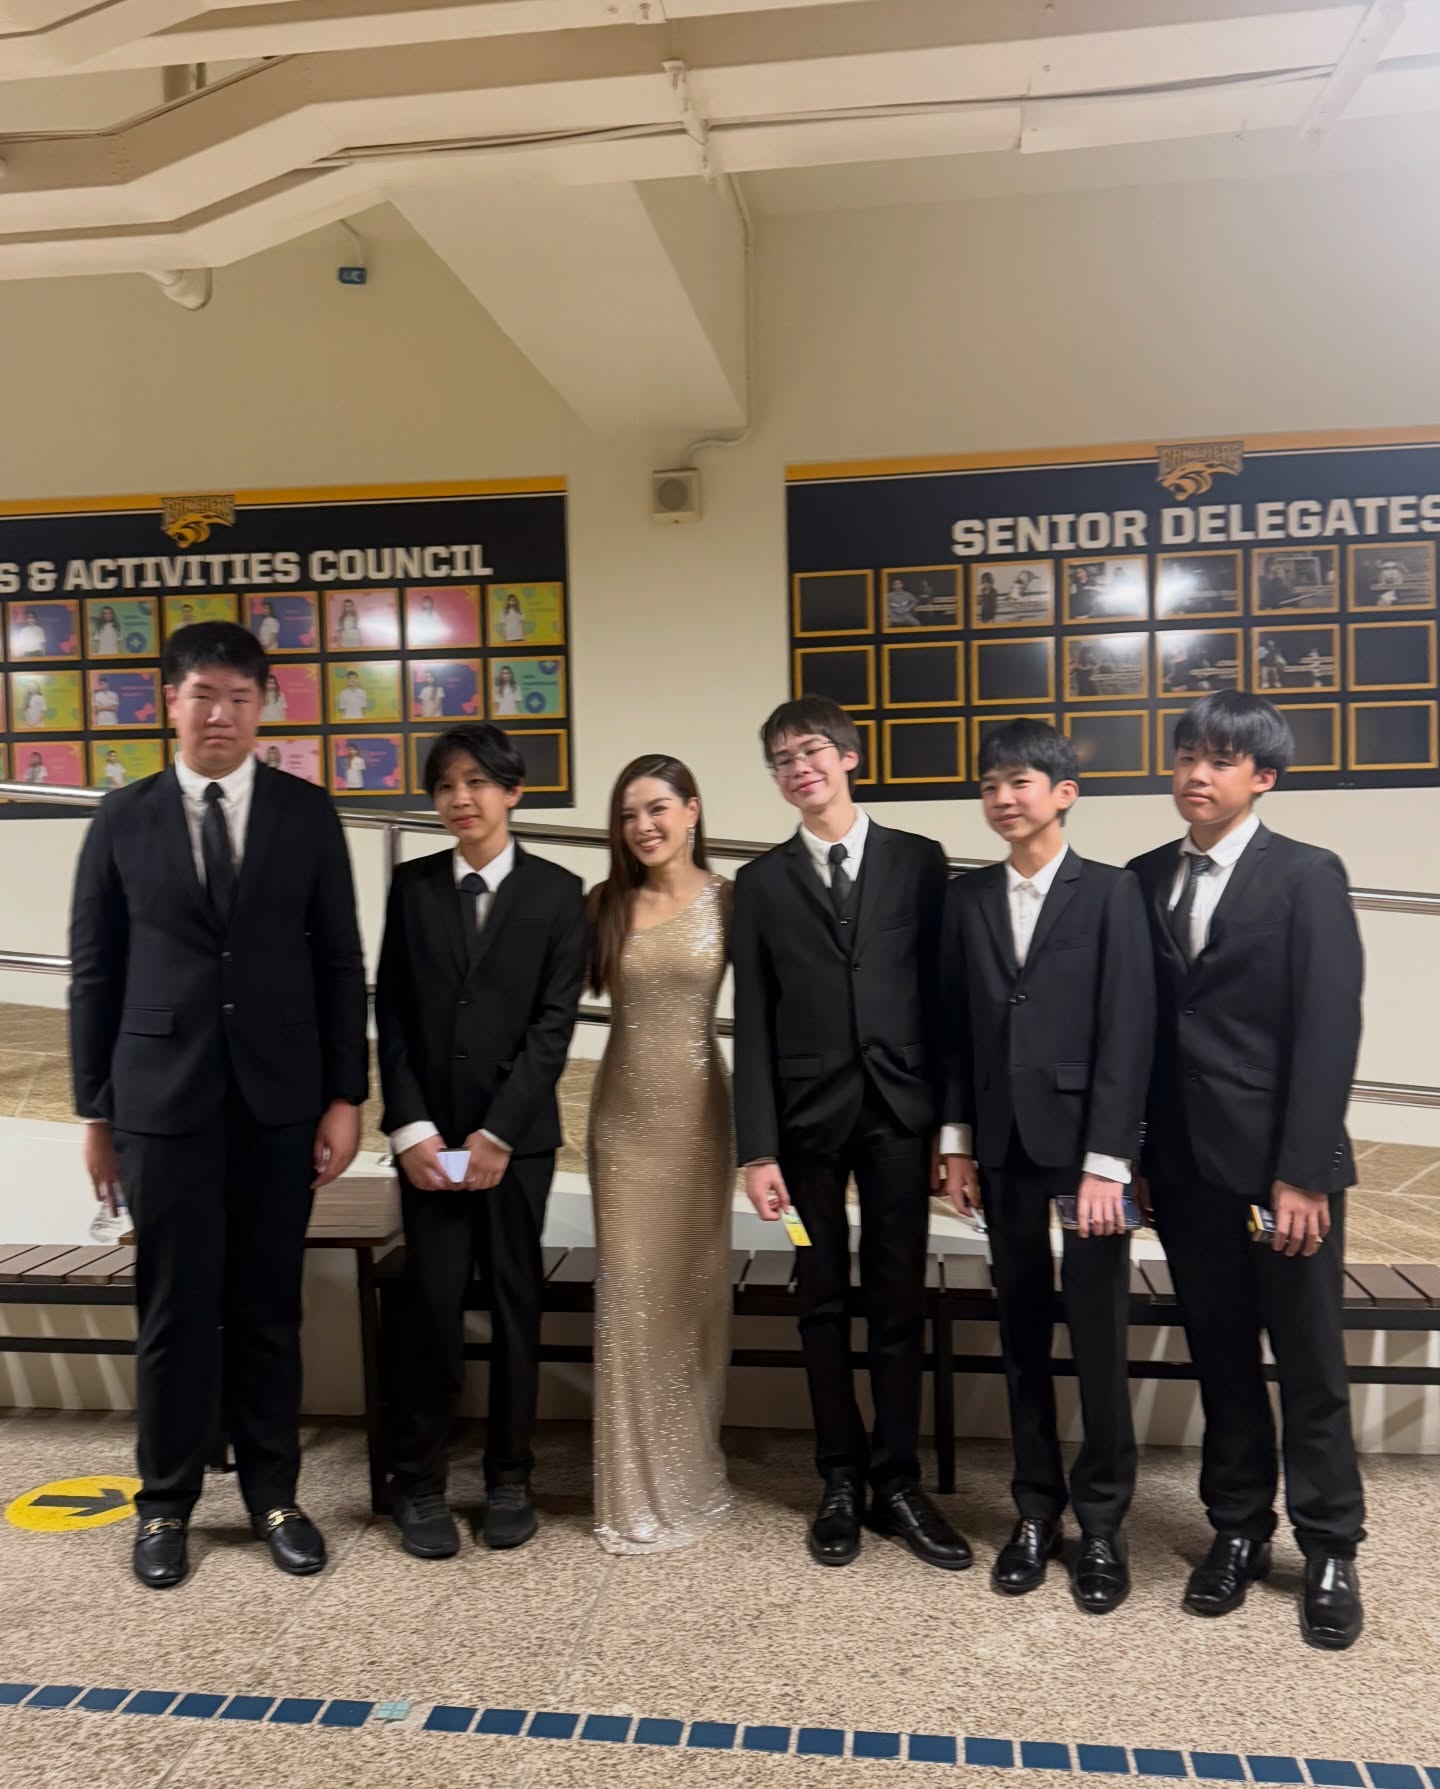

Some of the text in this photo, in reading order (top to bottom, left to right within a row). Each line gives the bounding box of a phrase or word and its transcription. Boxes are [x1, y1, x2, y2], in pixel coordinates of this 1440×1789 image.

[952, 494, 1440, 556] SENIOR DELEGATES
[27, 560, 57, 592] &
[64, 552, 300, 590] ACTIVITIES
[309, 544, 494, 582] COUNCIL
